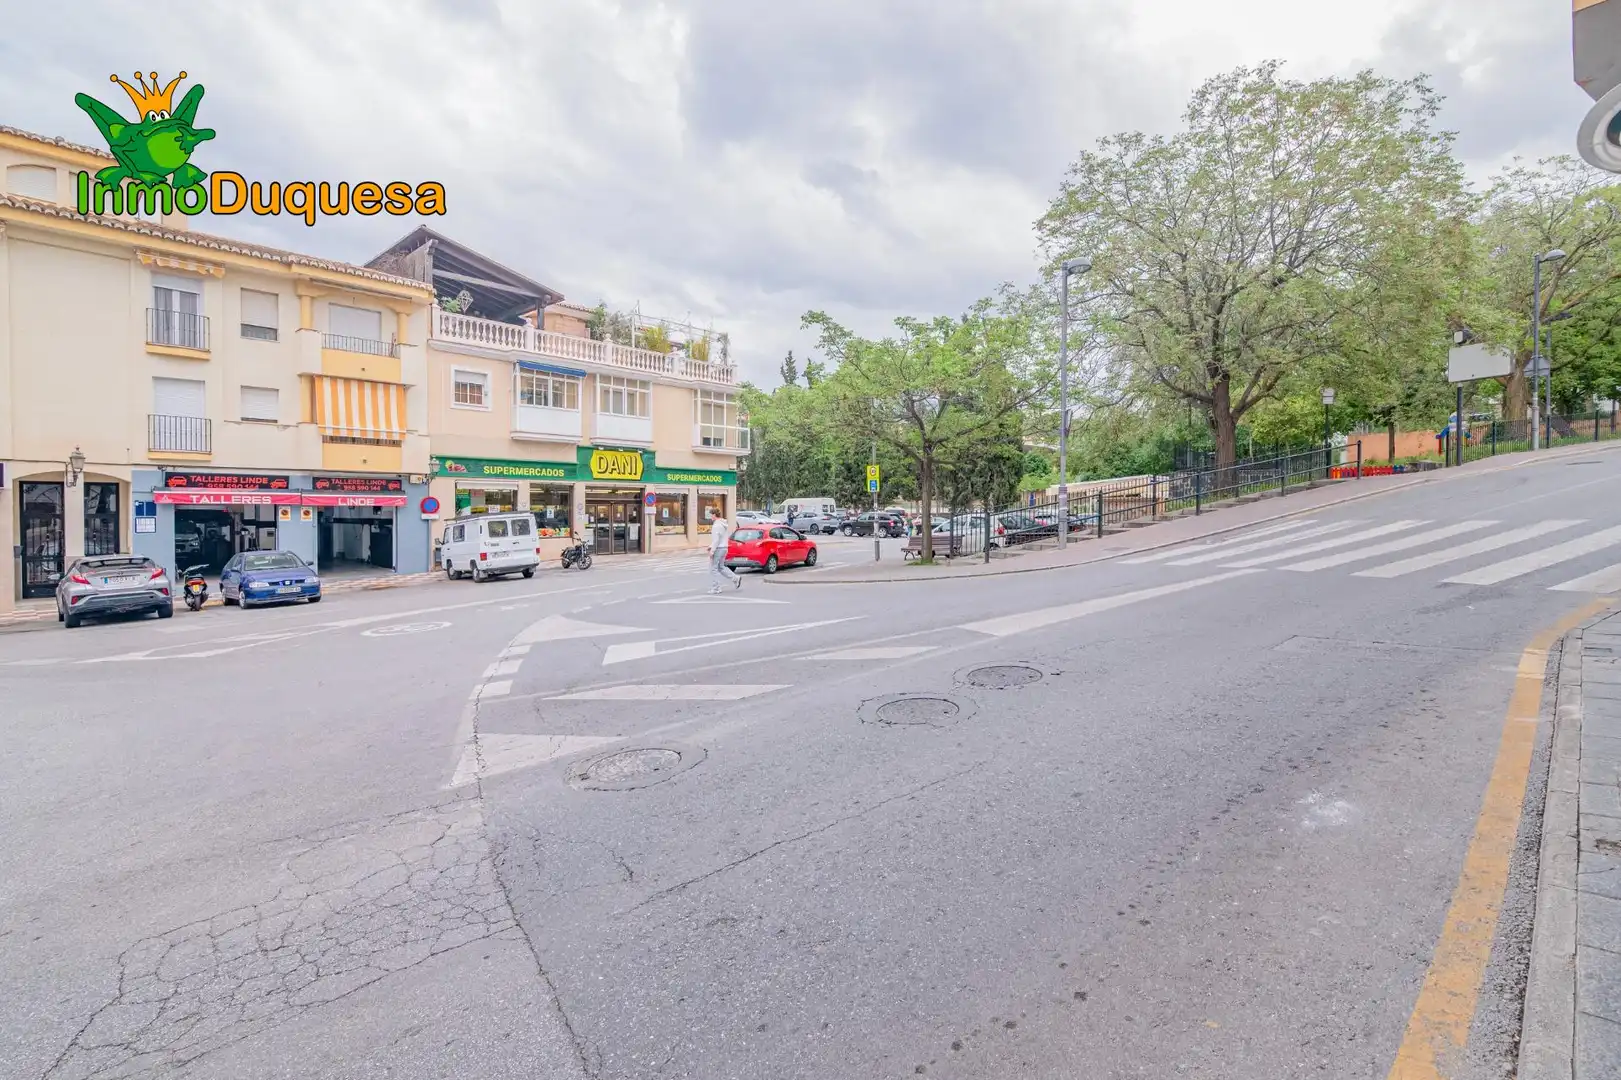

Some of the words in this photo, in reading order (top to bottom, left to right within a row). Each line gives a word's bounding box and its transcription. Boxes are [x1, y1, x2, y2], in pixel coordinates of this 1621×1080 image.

[597, 454, 638, 476] DANI
[483, 465, 565, 477] SUPERMERCADOS
[190, 475, 238, 483] TALLERES
[666, 473, 722, 483] SUPERMERCADOS
[189, 495, 272, 505] TALLERES
[338, 498, 376, 506] LINDE
